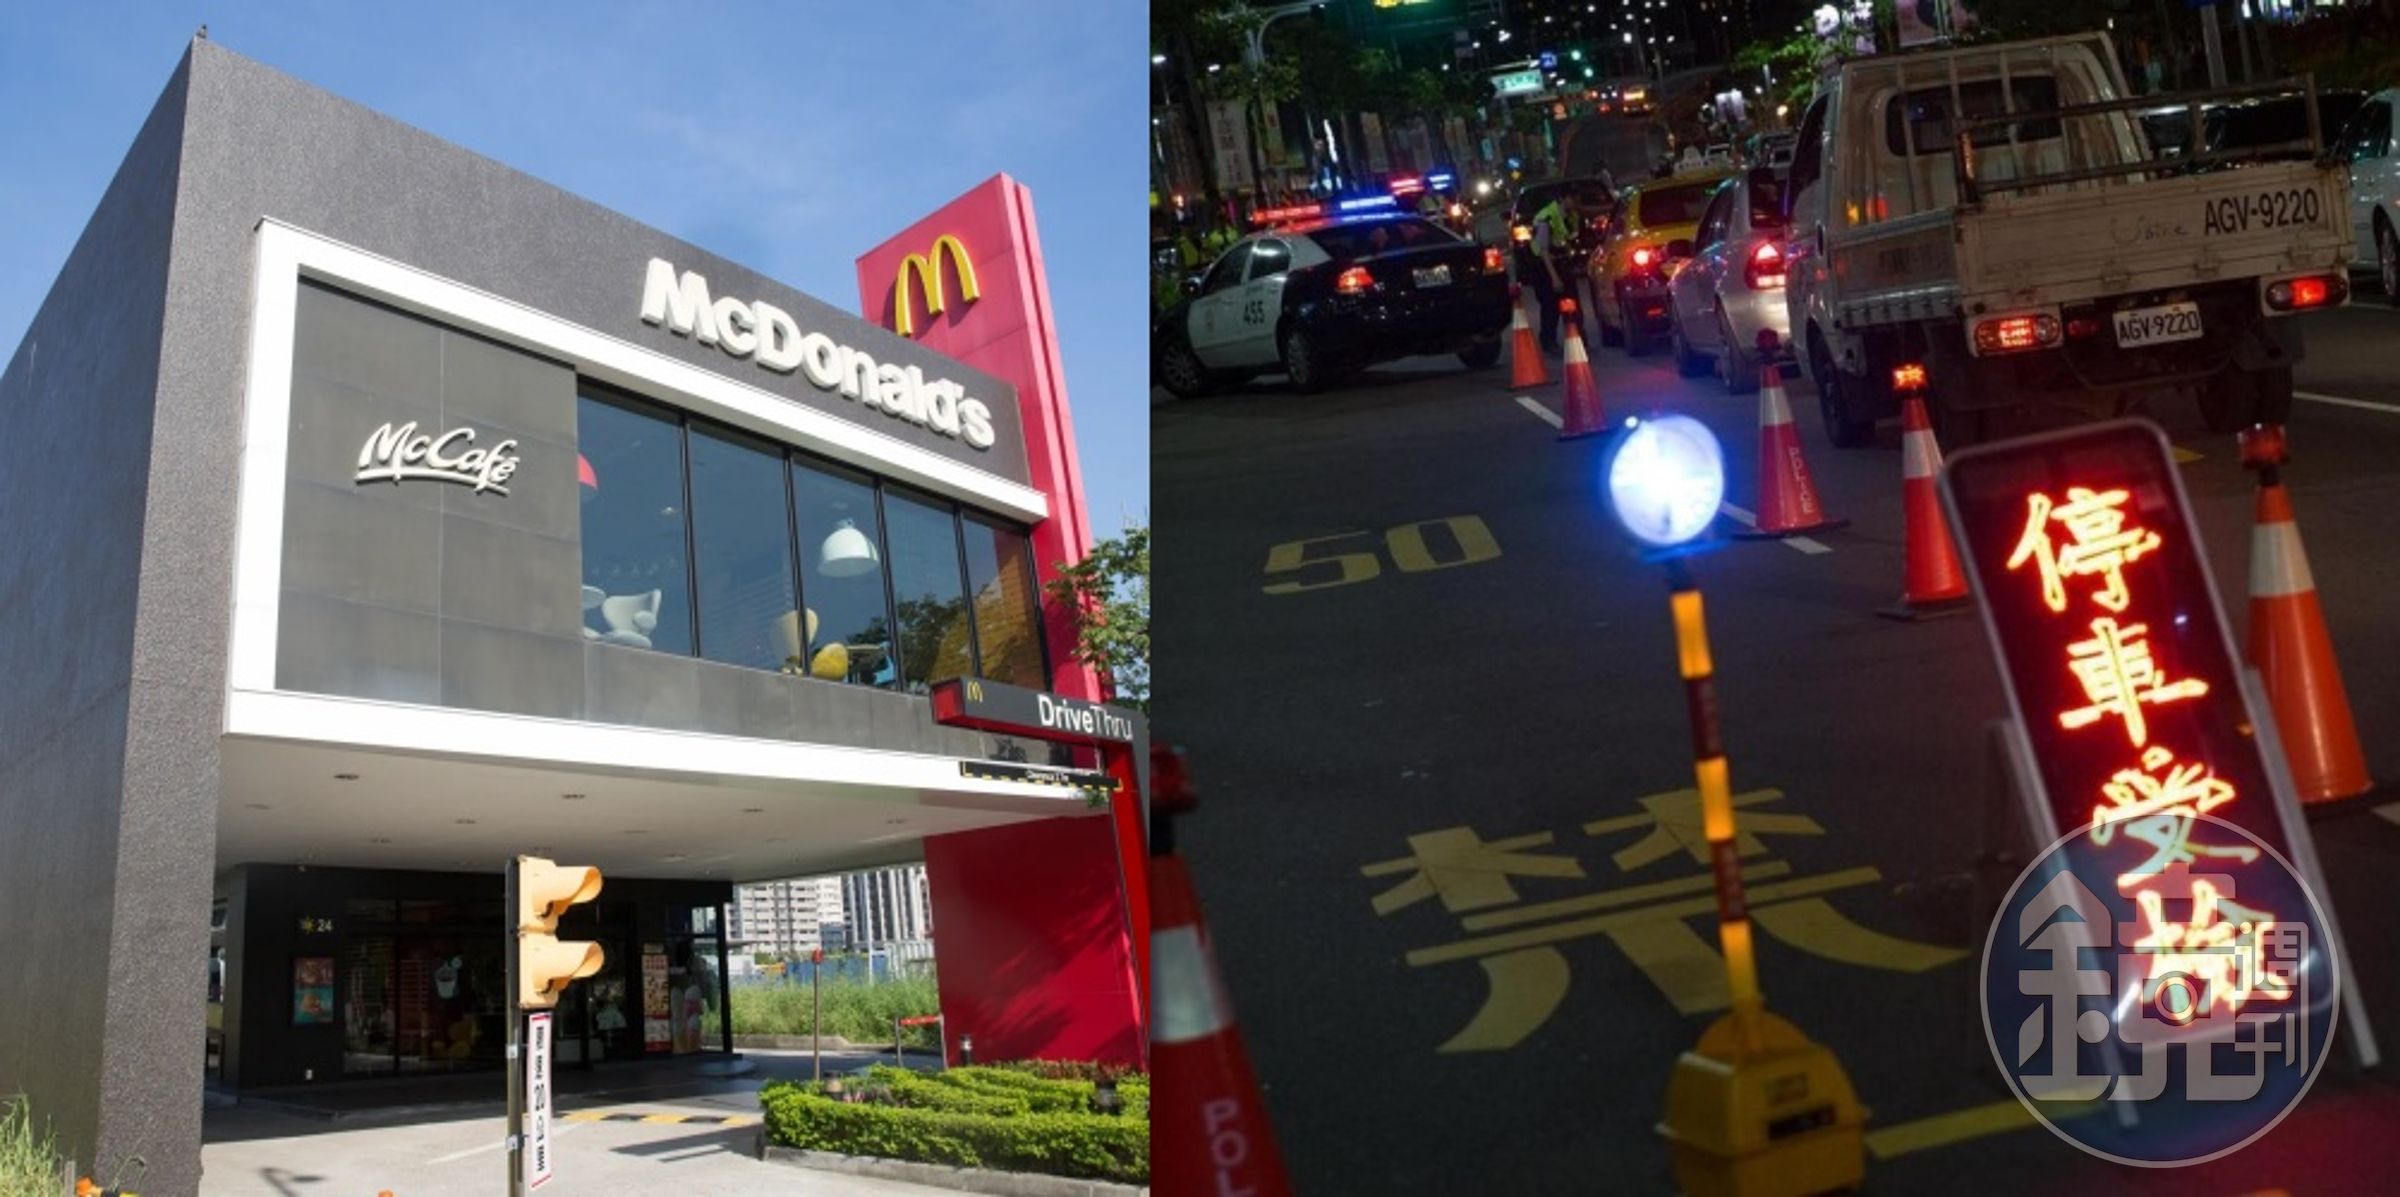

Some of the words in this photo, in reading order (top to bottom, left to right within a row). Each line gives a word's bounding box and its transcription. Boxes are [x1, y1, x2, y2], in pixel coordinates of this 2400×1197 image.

[2204, 188, 2320, 236] AGV-9220
[1243, 299, 1265, 326] 455
[2119, 311, 2199, 342] AGV-9220
[641, 257, 995, 449] McDonald's
[357, 421, 520, 493] McCafé
[1788, 447, 1815, 515] POLICE
[1261, 514, 1504, 596] 50
[317, 918, 333, 932] 24
[1361, 787, 1969, 1054] 禁
